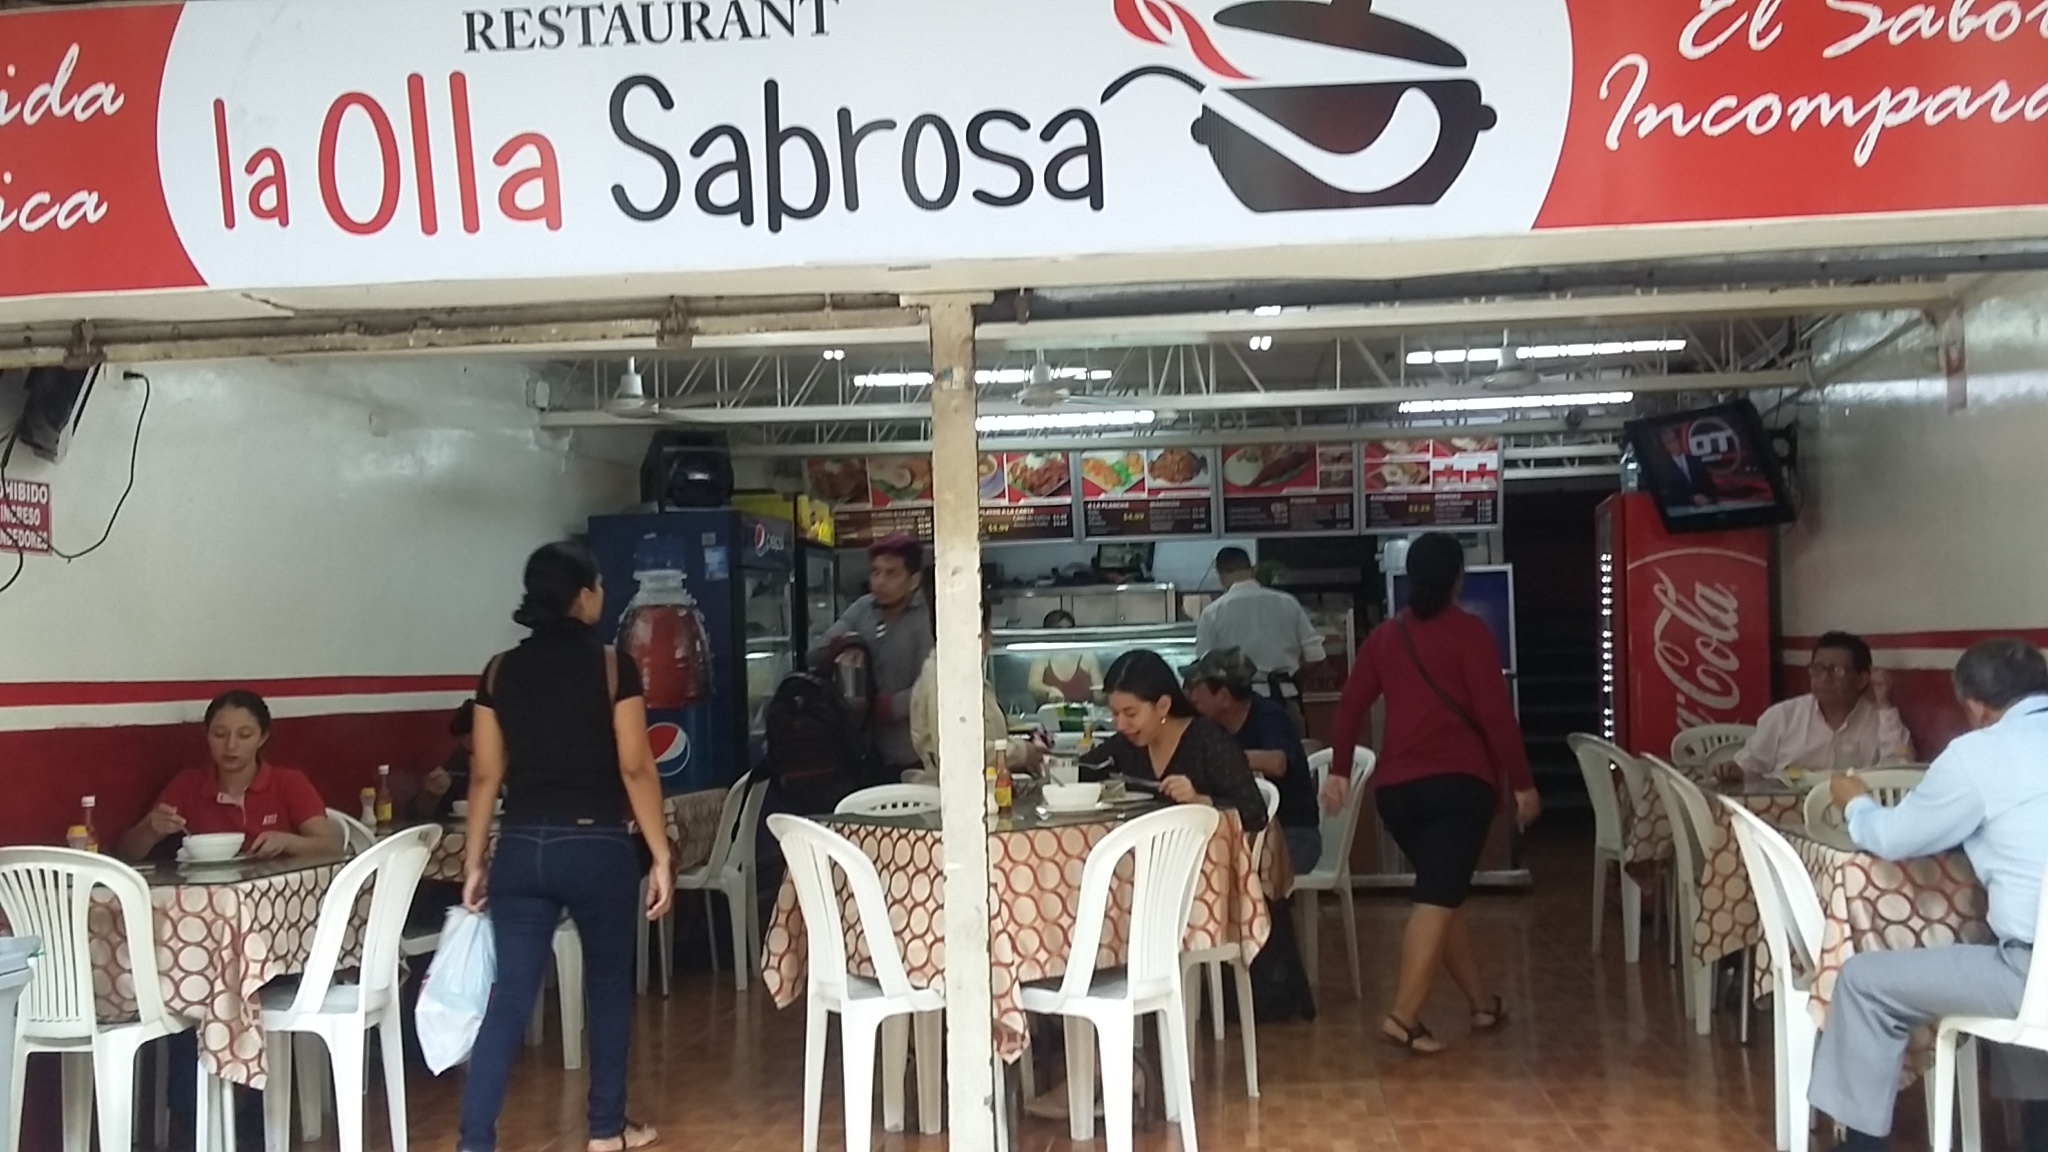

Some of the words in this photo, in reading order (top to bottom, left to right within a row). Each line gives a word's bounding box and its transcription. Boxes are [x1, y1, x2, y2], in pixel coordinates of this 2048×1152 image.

[463, 0, 839, 53] RESTAURANT
[1679, 0, 1783, 60] El
[213, 98, 289, 231] la
[317, 70, 563, 236] Olla
[609, 74, 1105, 234] Sabrosa
